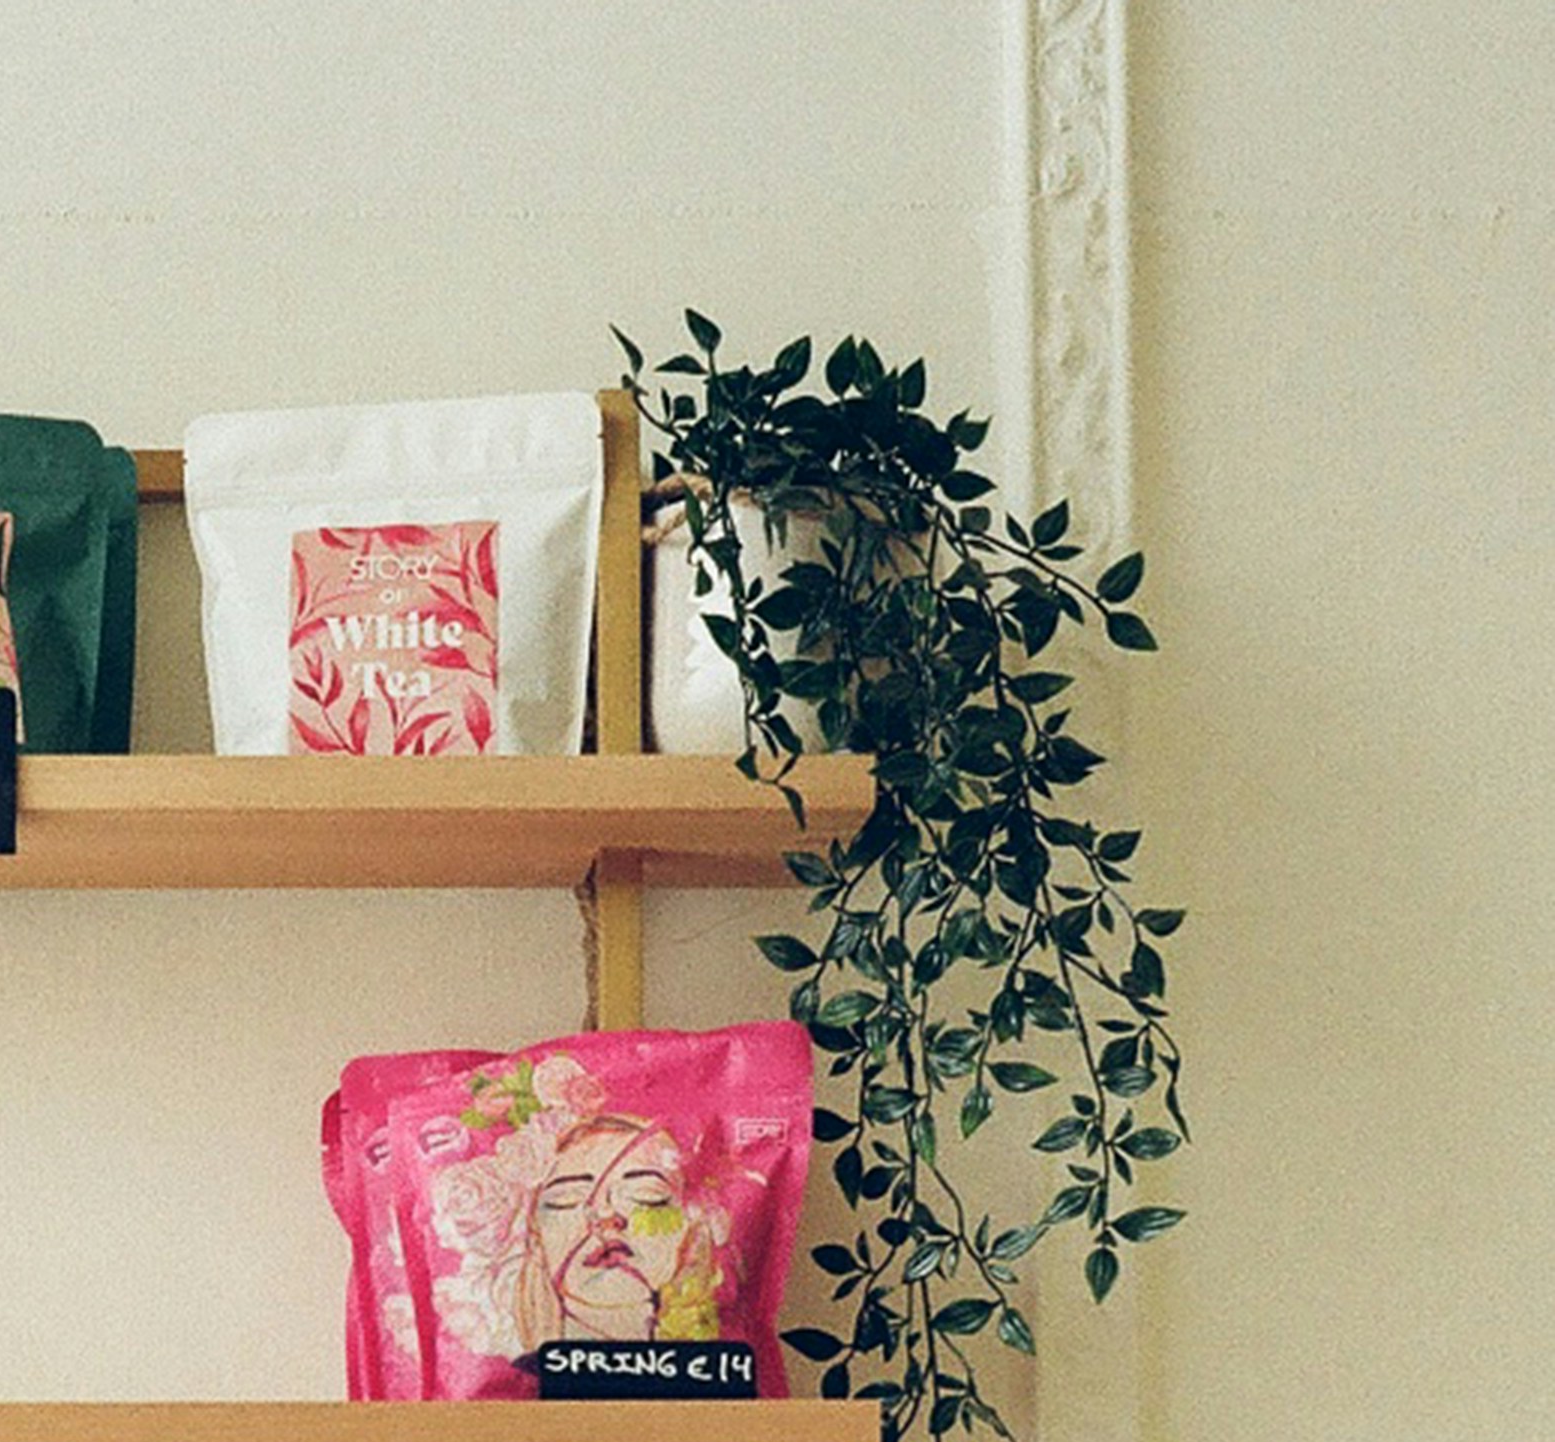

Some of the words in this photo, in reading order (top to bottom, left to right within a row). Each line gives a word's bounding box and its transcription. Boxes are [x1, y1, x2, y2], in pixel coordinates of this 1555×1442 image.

[349, 553, 438, 582] STORY
[325, 610, 465, 651] White
[351, 660, 432, 699] Tea
[545, 1349, 678, 1378] SPRING
